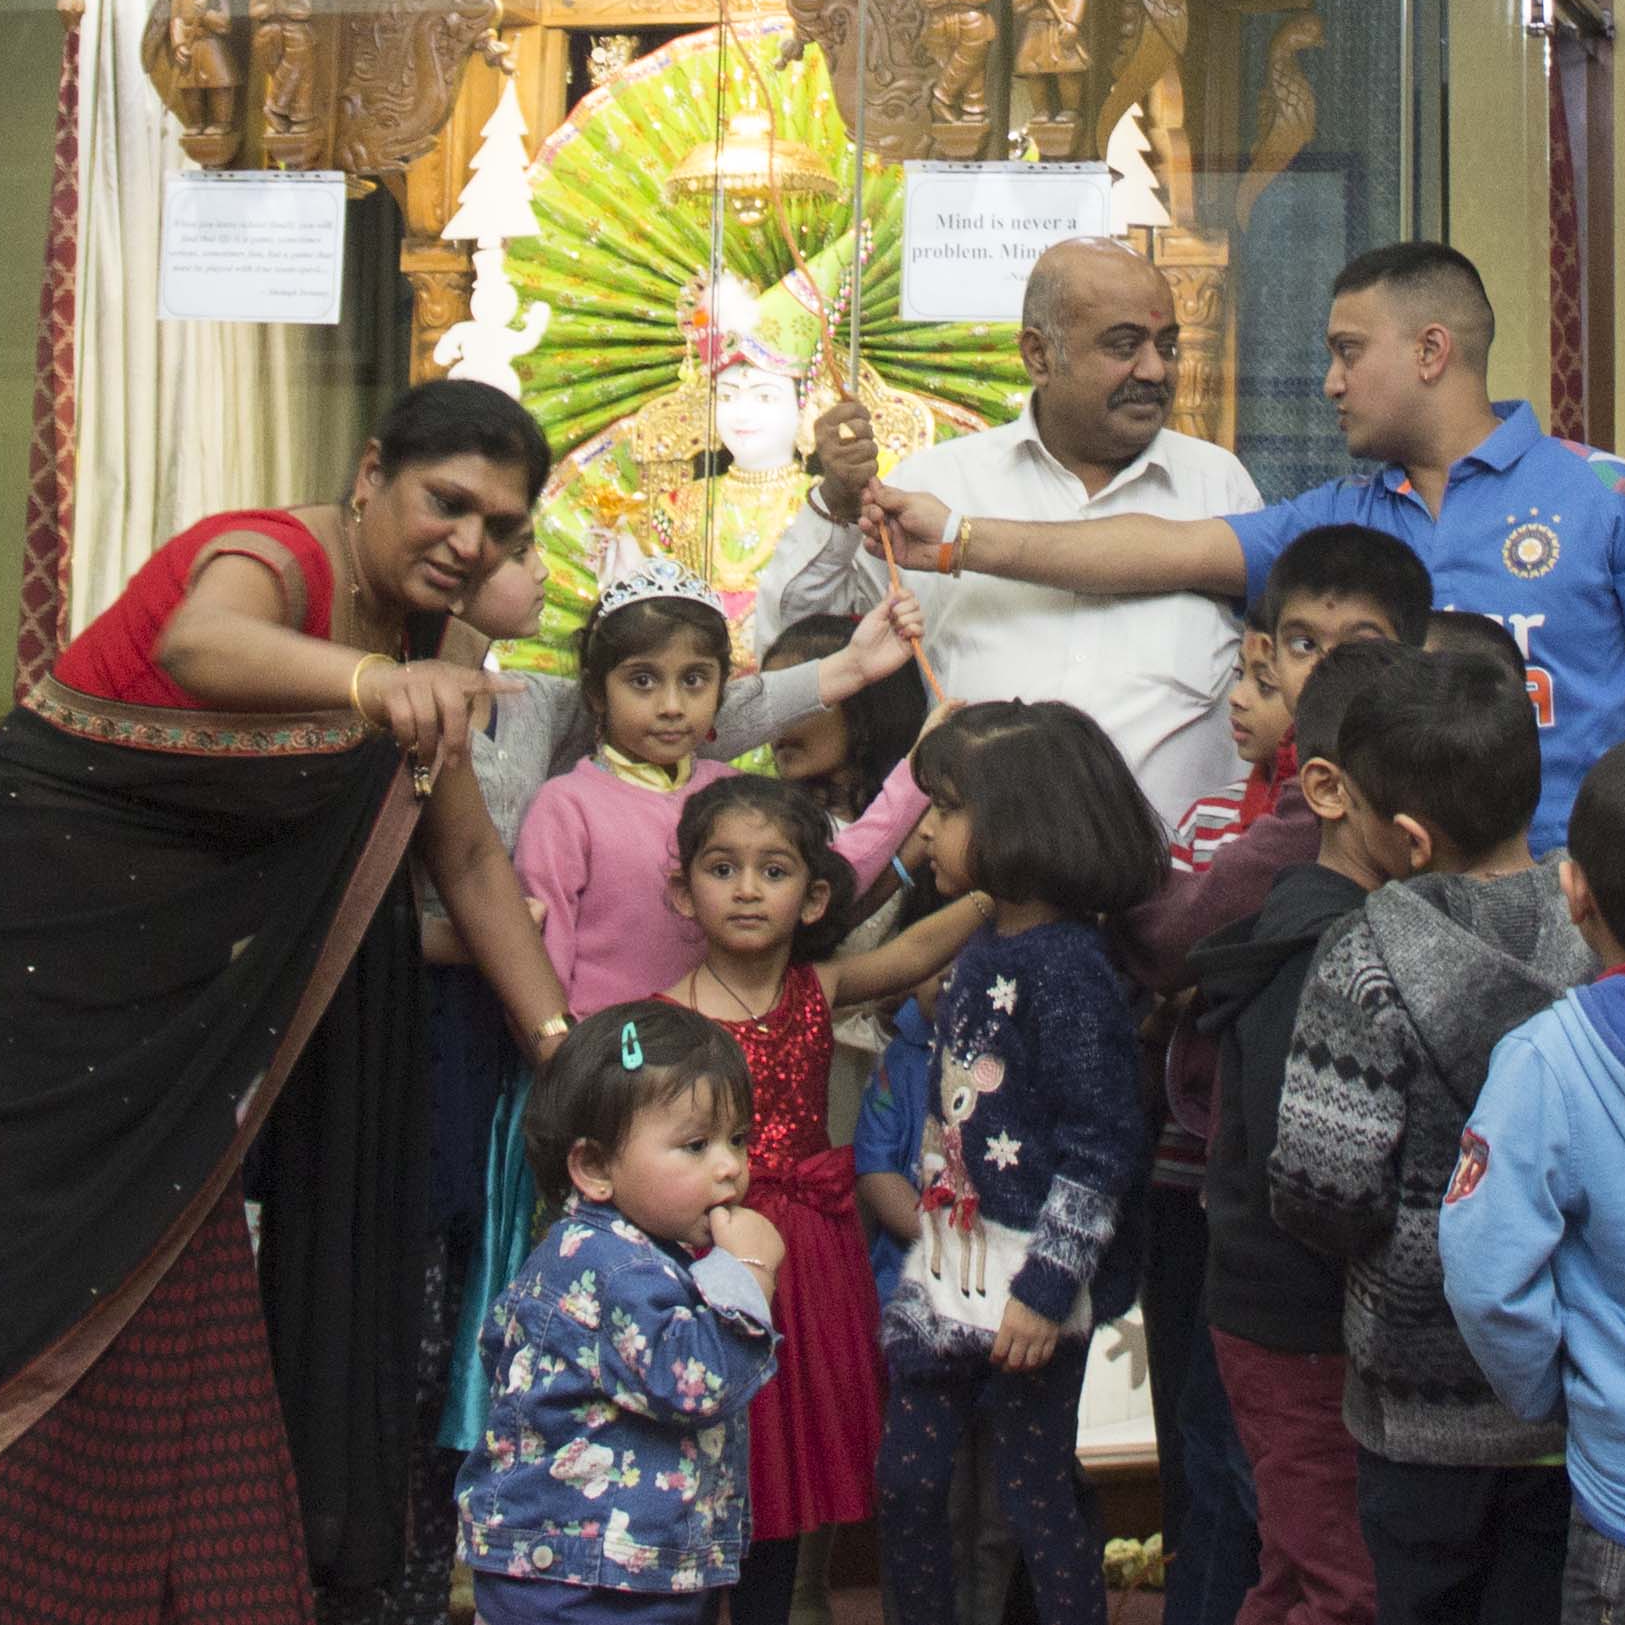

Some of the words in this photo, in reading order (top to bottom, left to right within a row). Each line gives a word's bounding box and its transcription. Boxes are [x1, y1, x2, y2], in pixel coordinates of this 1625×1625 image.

[936, 213, 984, 231] Mind
[991, 213, 1005, 231] is
[1011, 216, 1062, 231] never
[1067, 217, 1078, 231] a
[911, 242, 993, 263] problem.
